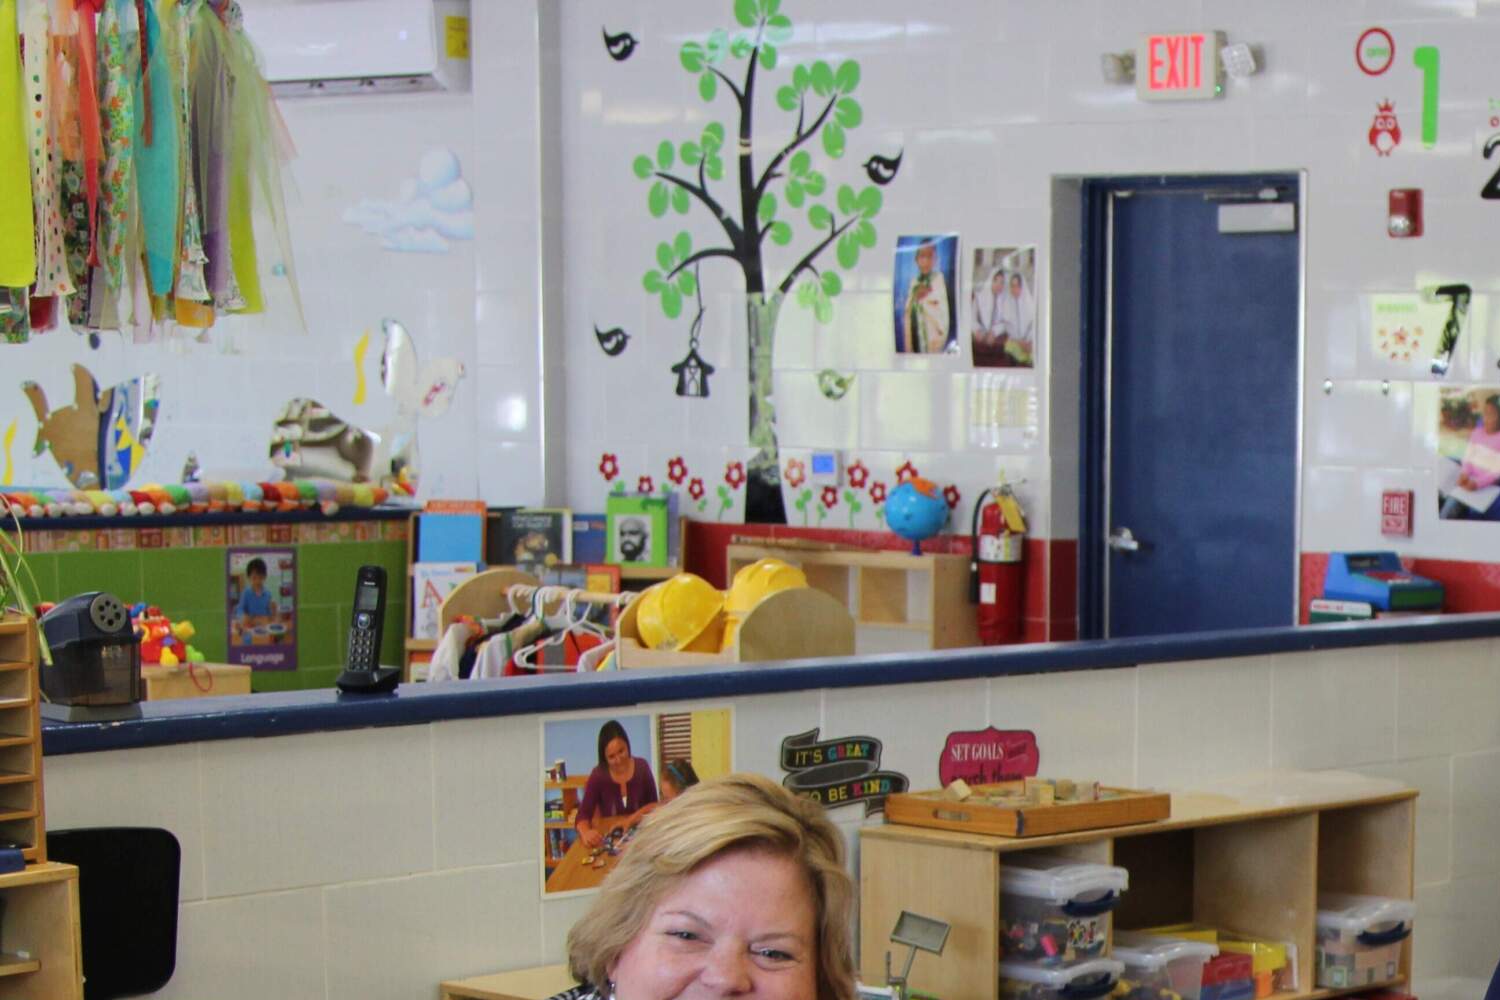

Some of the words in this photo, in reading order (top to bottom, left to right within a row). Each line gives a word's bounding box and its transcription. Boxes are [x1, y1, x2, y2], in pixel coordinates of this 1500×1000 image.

[1147, 34, 1205, 90] EXIT
[1413, 46, 1440, 149] 1
[1430, 284, 1472, 376] 7
[795, 749, 823, 766] IT'S
[827, 743, 870, 762] GREAT
[951, 743, 971, 761] SET
[972, 741, 1005, 761] GOALS
[828, 785, 848, 802] BE
[852, 779, 891, 799] KIND
